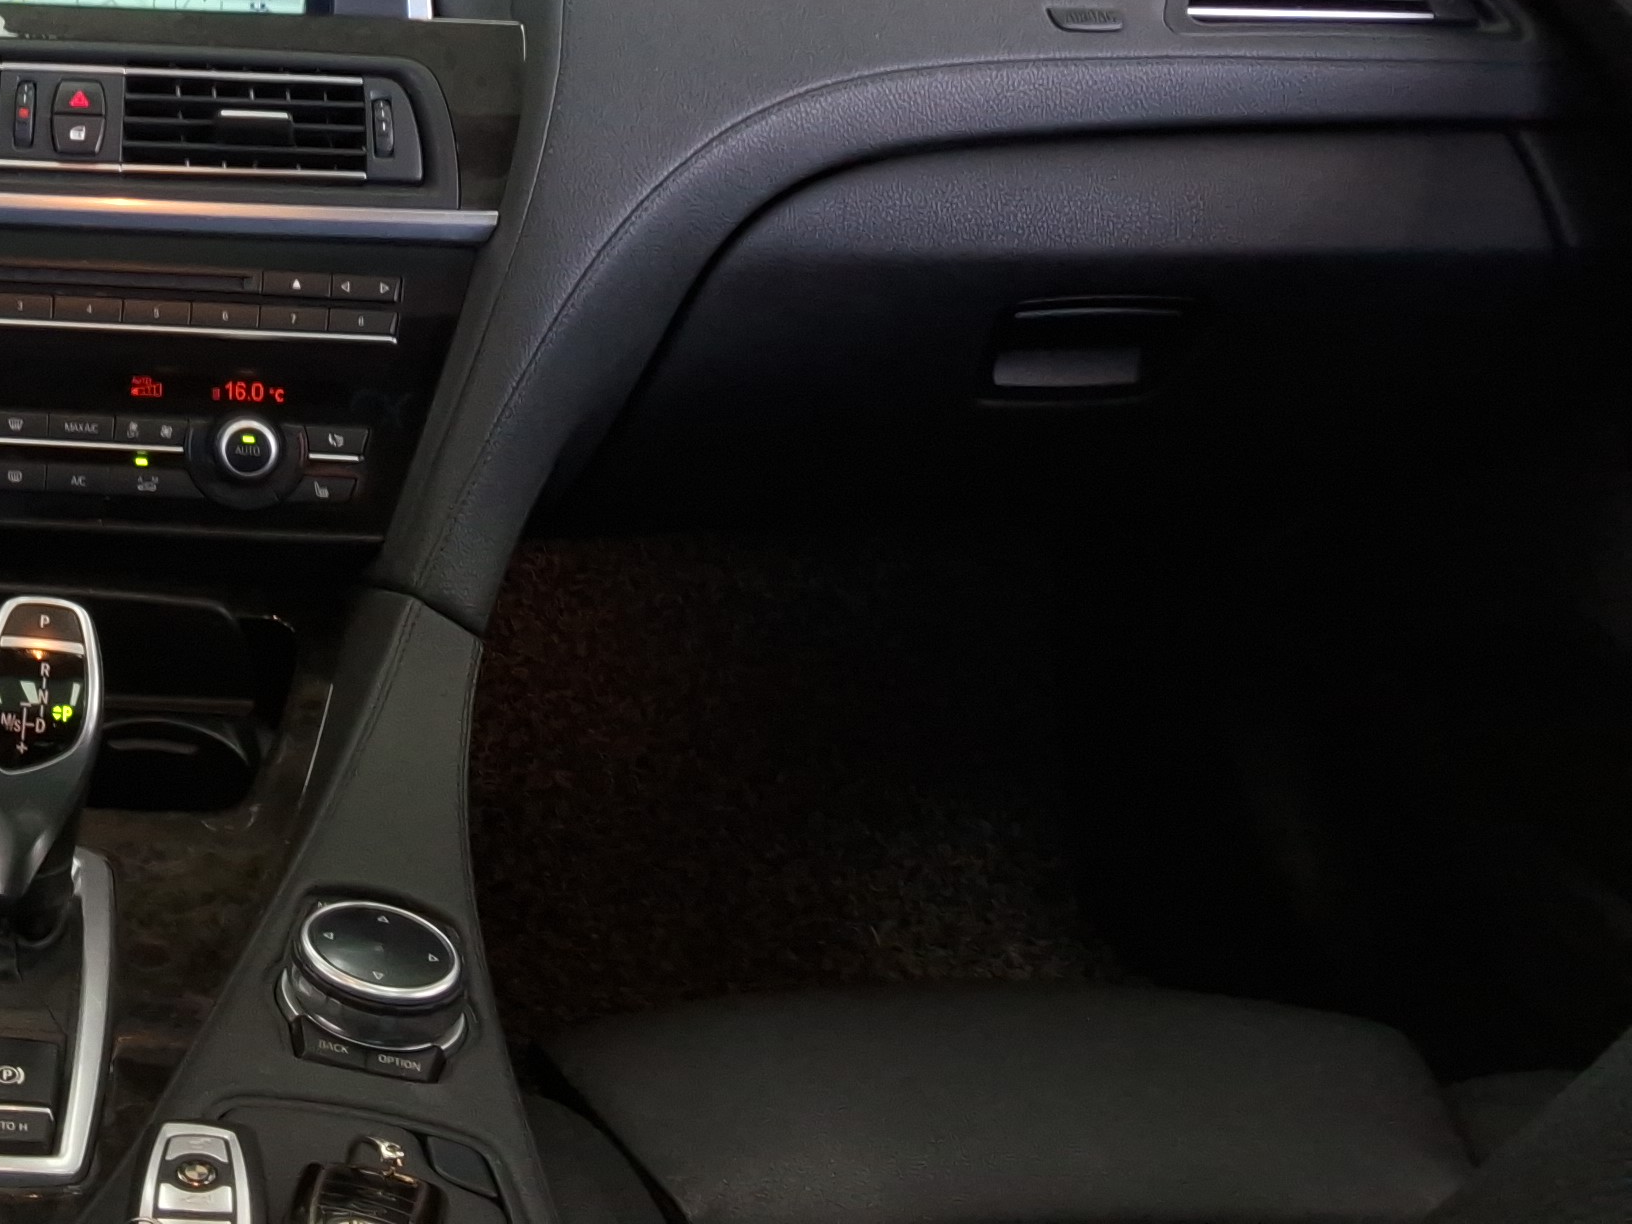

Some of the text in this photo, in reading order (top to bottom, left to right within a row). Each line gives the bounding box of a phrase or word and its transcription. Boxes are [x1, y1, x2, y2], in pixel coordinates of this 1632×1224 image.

[225, 381, 265, 402] 16.0
[235, 445, 261, 456] AUTO
[70, 476, 86, 487] A/C
[40, 614, 51, 628] P
[40, 663, 51, 677] R
[38, 689, 49, 704] N
[63, 706, 73, 722] P
[35, 717, 46, 733] D
[319, 1040, 349, 1055] BACK
[378, 1054, 421, 1072] OPTION
[2, 1069, 13, 1080] P
[19, 1122, 29, 1132] H
